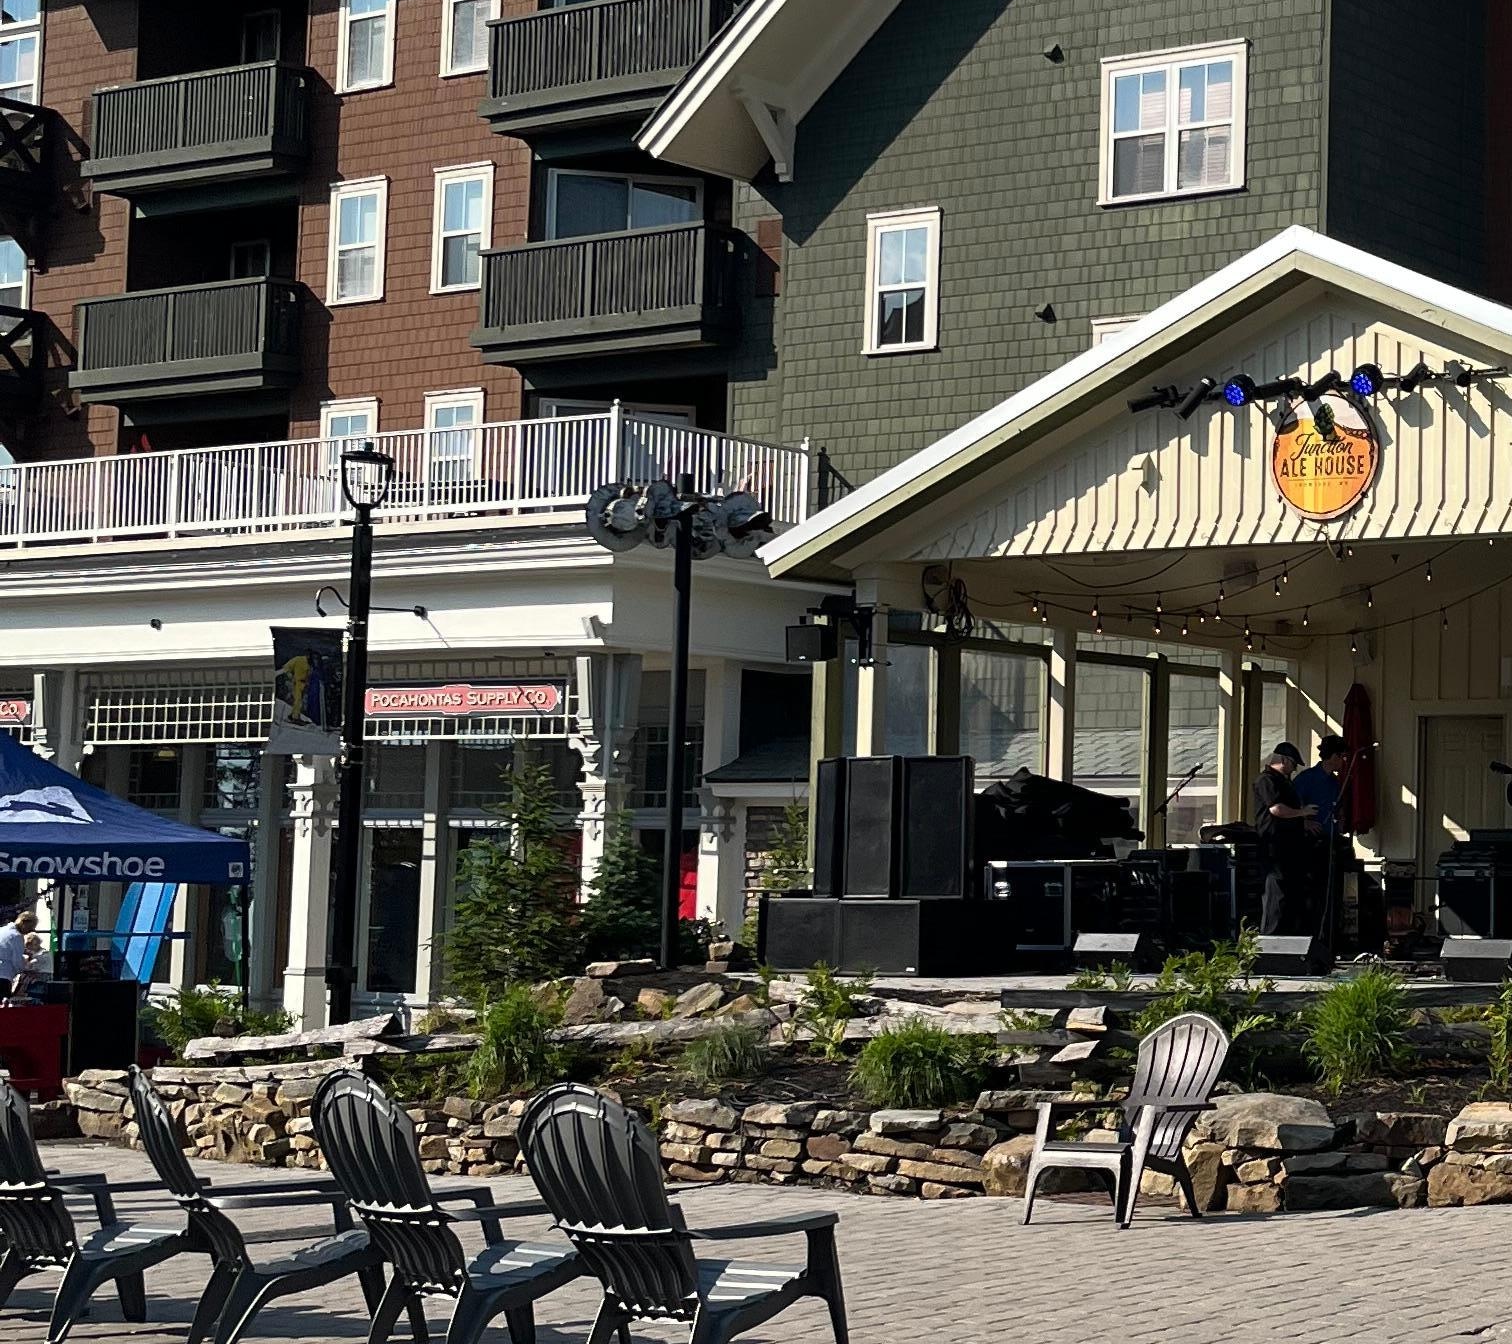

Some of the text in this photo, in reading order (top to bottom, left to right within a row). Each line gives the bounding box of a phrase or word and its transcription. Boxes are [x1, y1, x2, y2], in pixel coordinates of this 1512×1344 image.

[1280, 455, 1365, 478] ALE HOUSE
[370, 692, 461, 707] POCAHONTAS
[466, 691, 522, 706] SUPPLY
